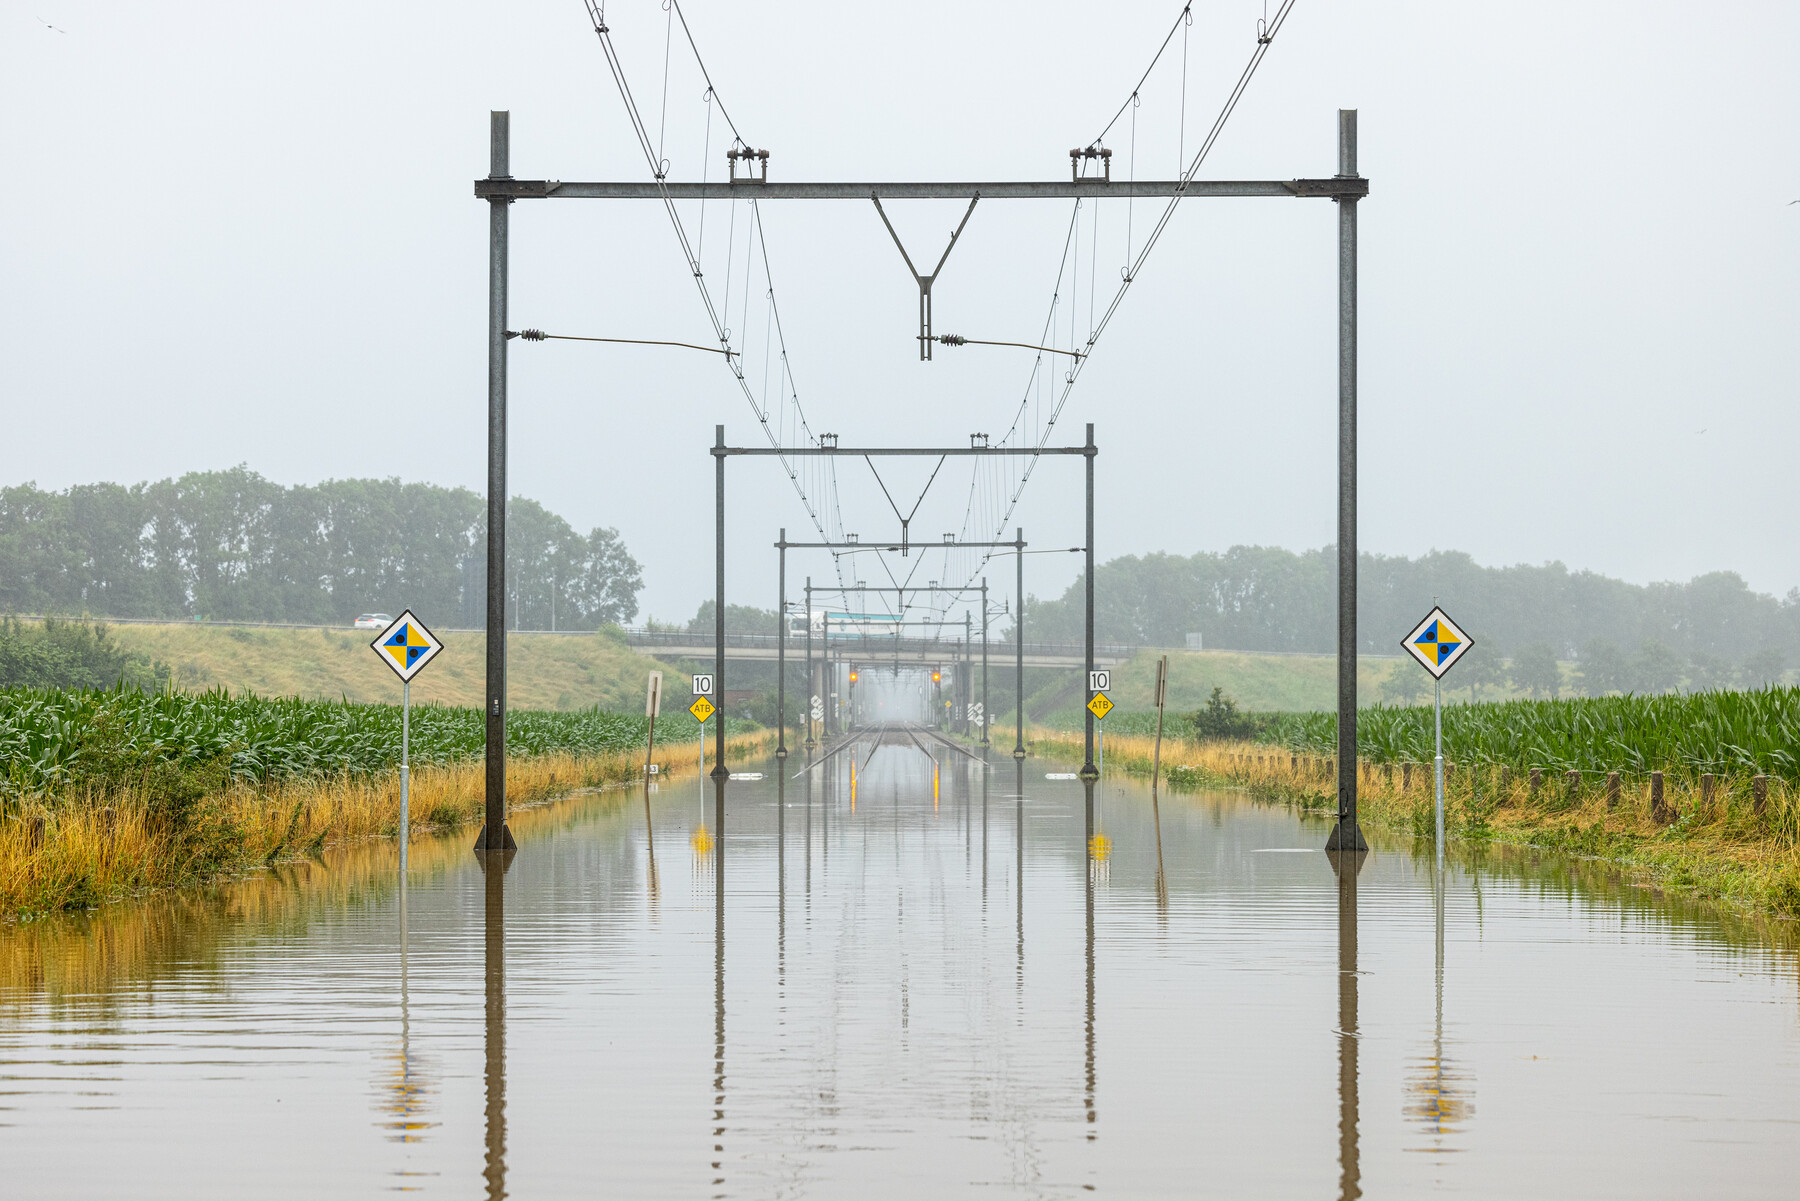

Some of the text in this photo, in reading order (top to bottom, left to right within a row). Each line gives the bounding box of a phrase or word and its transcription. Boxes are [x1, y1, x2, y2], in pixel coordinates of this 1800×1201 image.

[695, 677, 710, 692] 10
[1092, 673, 1107, 688] 10
[694, 704, 710, 712] ATB
[1092, 701, 1108, 709] ATB
